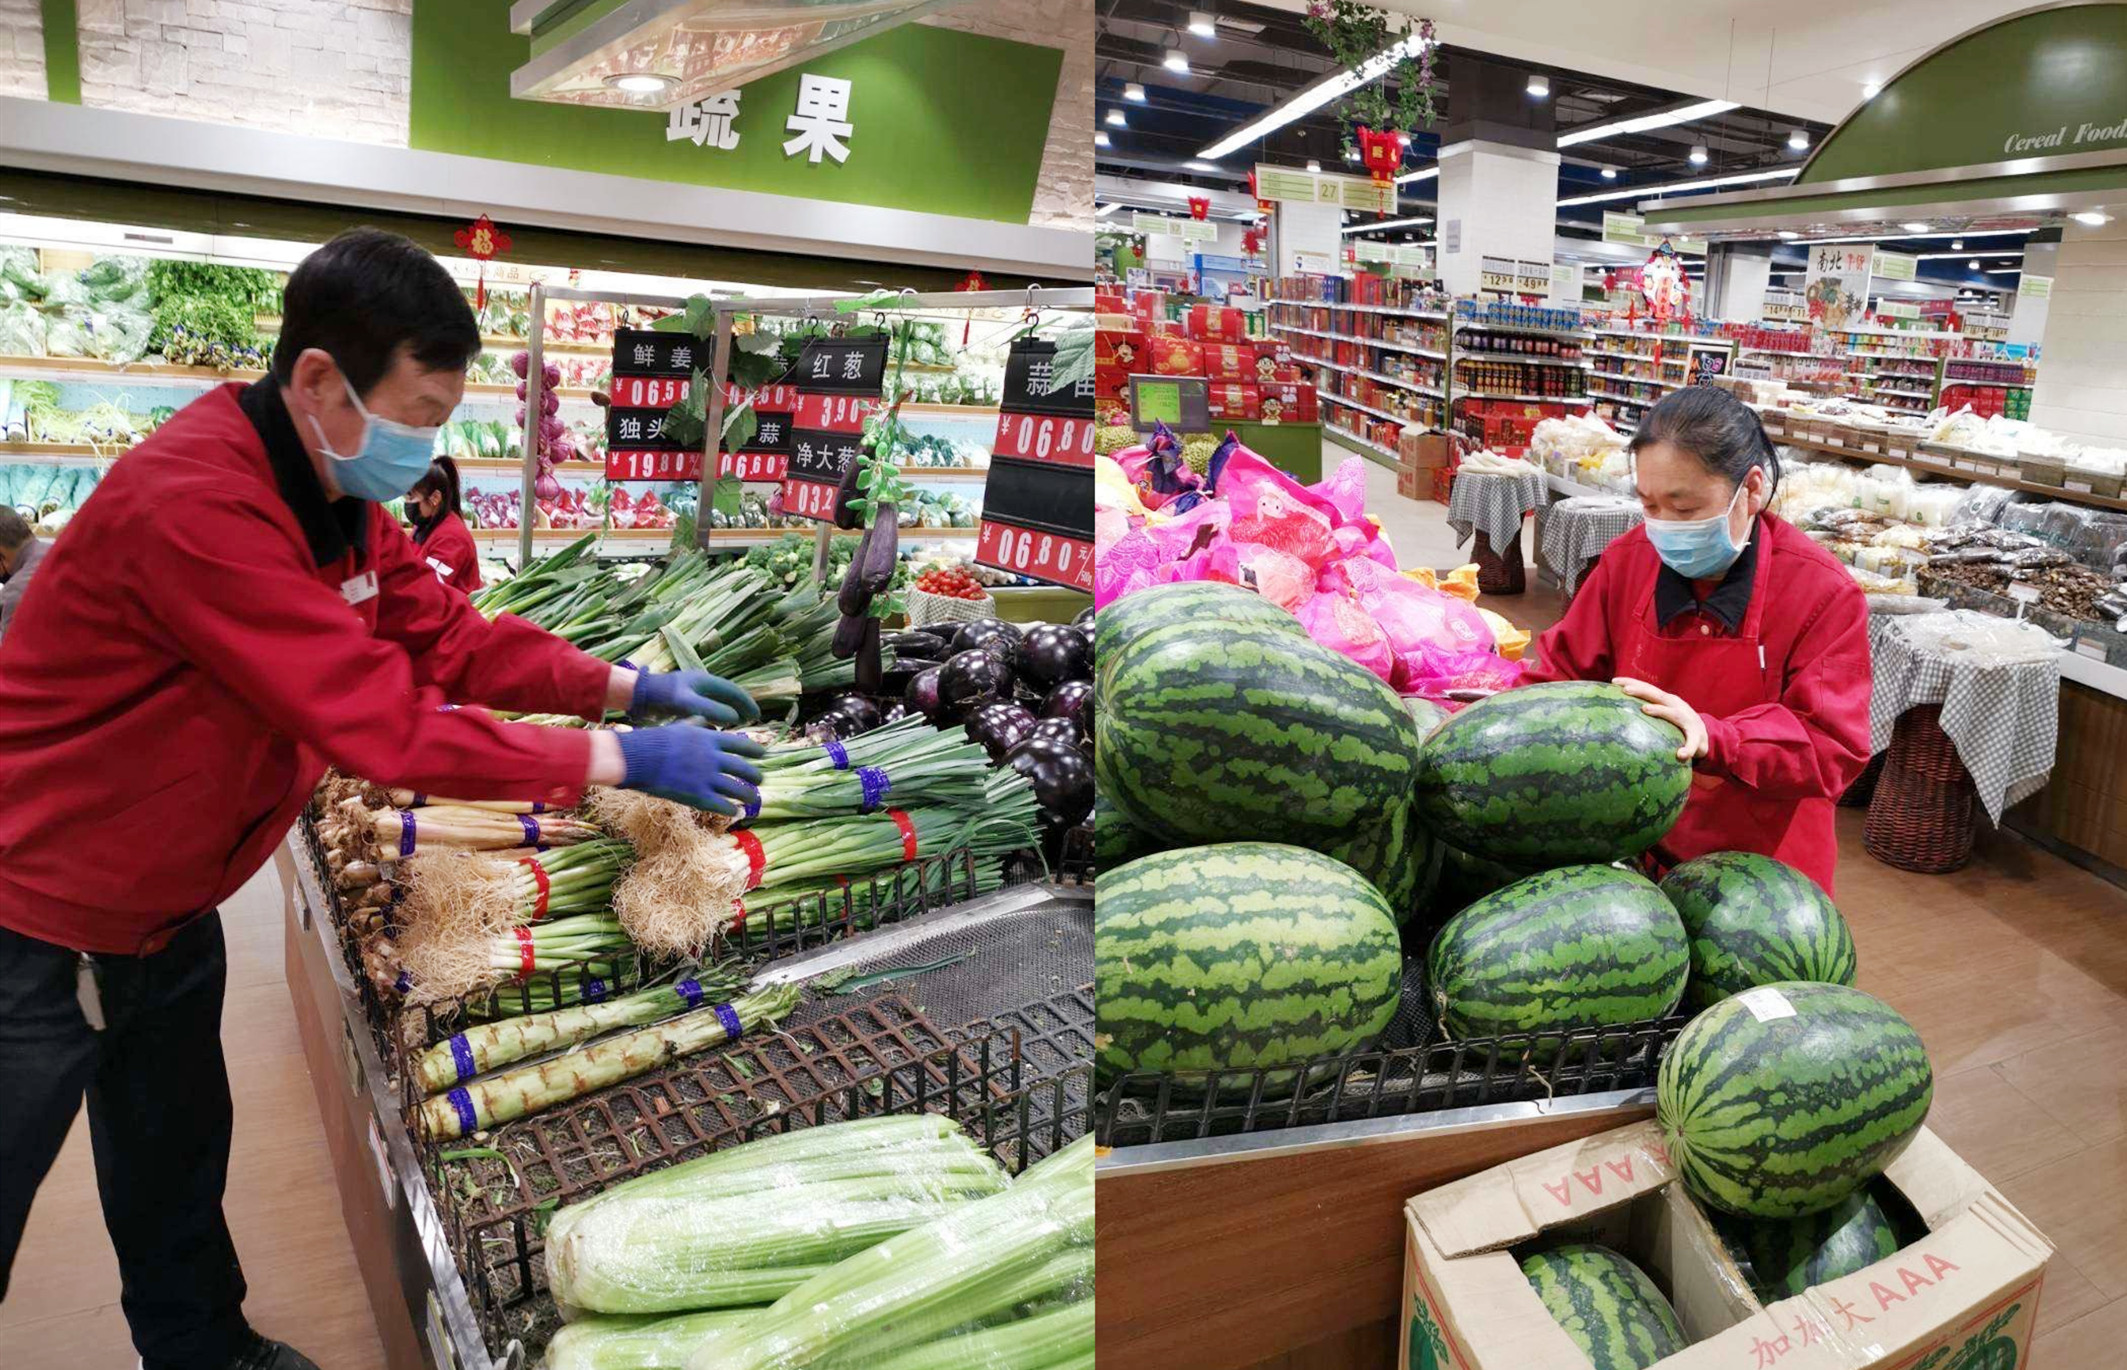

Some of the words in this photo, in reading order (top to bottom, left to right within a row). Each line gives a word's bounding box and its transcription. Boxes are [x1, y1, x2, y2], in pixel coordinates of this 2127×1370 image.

[2003, 126, 2068, 154] Cereal
[1320, 183, 1337, 199] 27
[633, 343, 692, 369] 鲜姜
[812, 350, 865, 380] 红葱
[821, 397, 859, 428] 3.90
[1016, 416, 1095, 458] 06.80
[720, 453, 776, 479] 06.60
[796, 441, 855, 473] 净大葱
[997, 528, 1073, 573] 06.80
